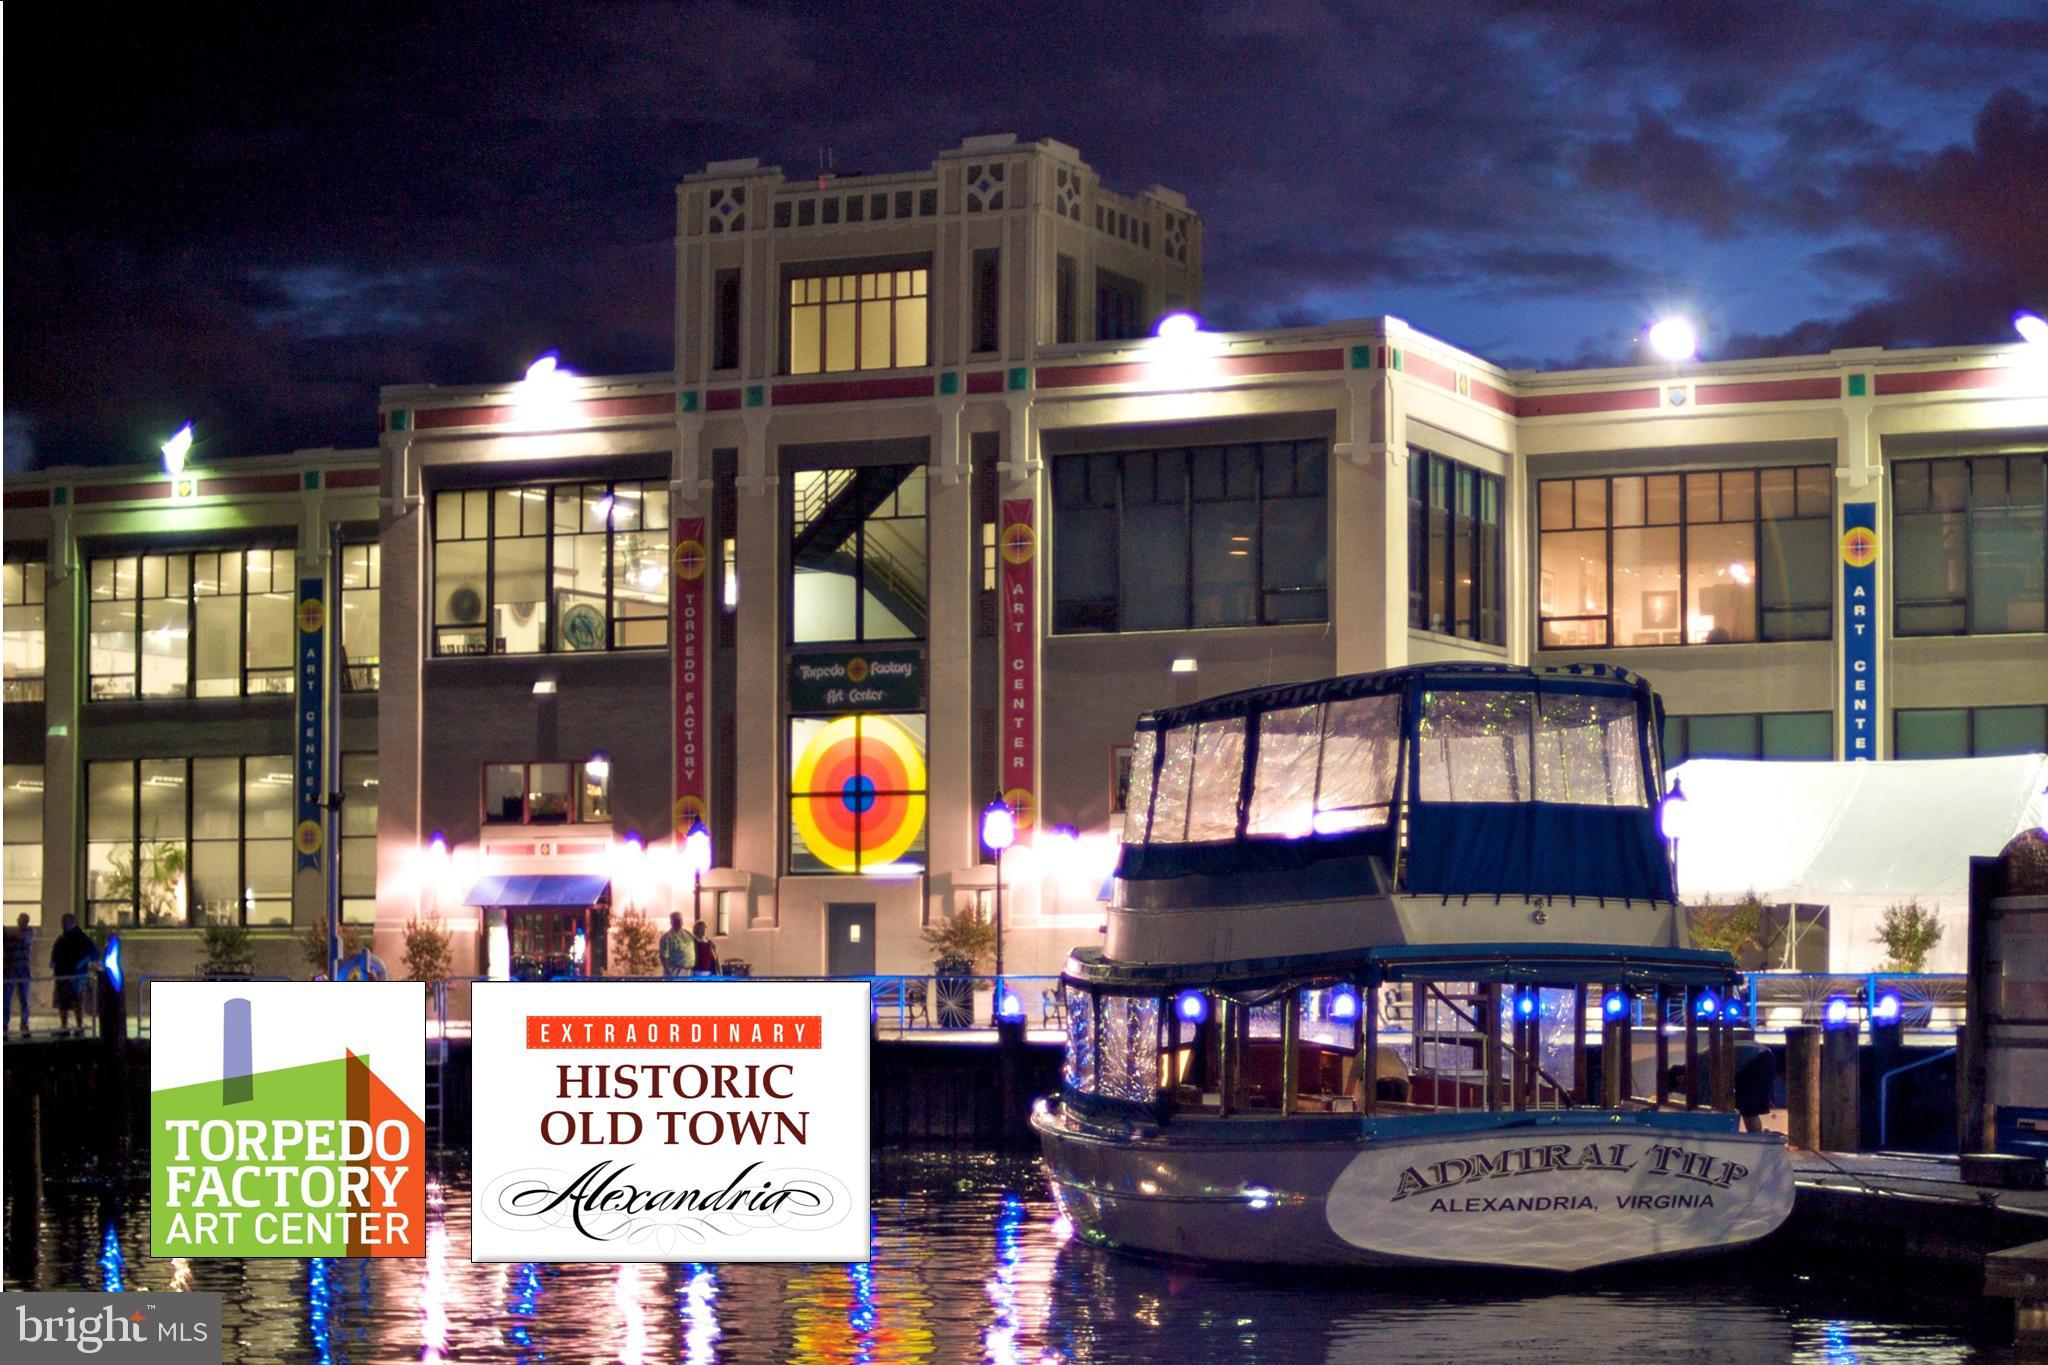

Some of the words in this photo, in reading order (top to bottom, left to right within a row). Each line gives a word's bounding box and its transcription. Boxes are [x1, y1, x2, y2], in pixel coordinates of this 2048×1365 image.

[1013, 584, 1025, 633] ART
[1854, 585, 1866, 635] ART
[684, 594, 696, 683] TORPEDO
[306, 648, 316, 691] ART
[800, 663, 846, 680] Torpedo
[871, 661, 912, 676] Factory
[826, 689, 844, 703] Art
[848, 688, 883, 702] Center
[1013, 659, 1025, 768] CENTER
[684, 692, 696, 781] FACTORY
[1390, 1143, 1639, 1202] ADMIRAL
[1645, 1143, 1749, 1190] TILP
[1430, 1195, 1599, 1213] ALEXANDRIA,
[1616, 1194, 1714, 1209] VIRGINIA
